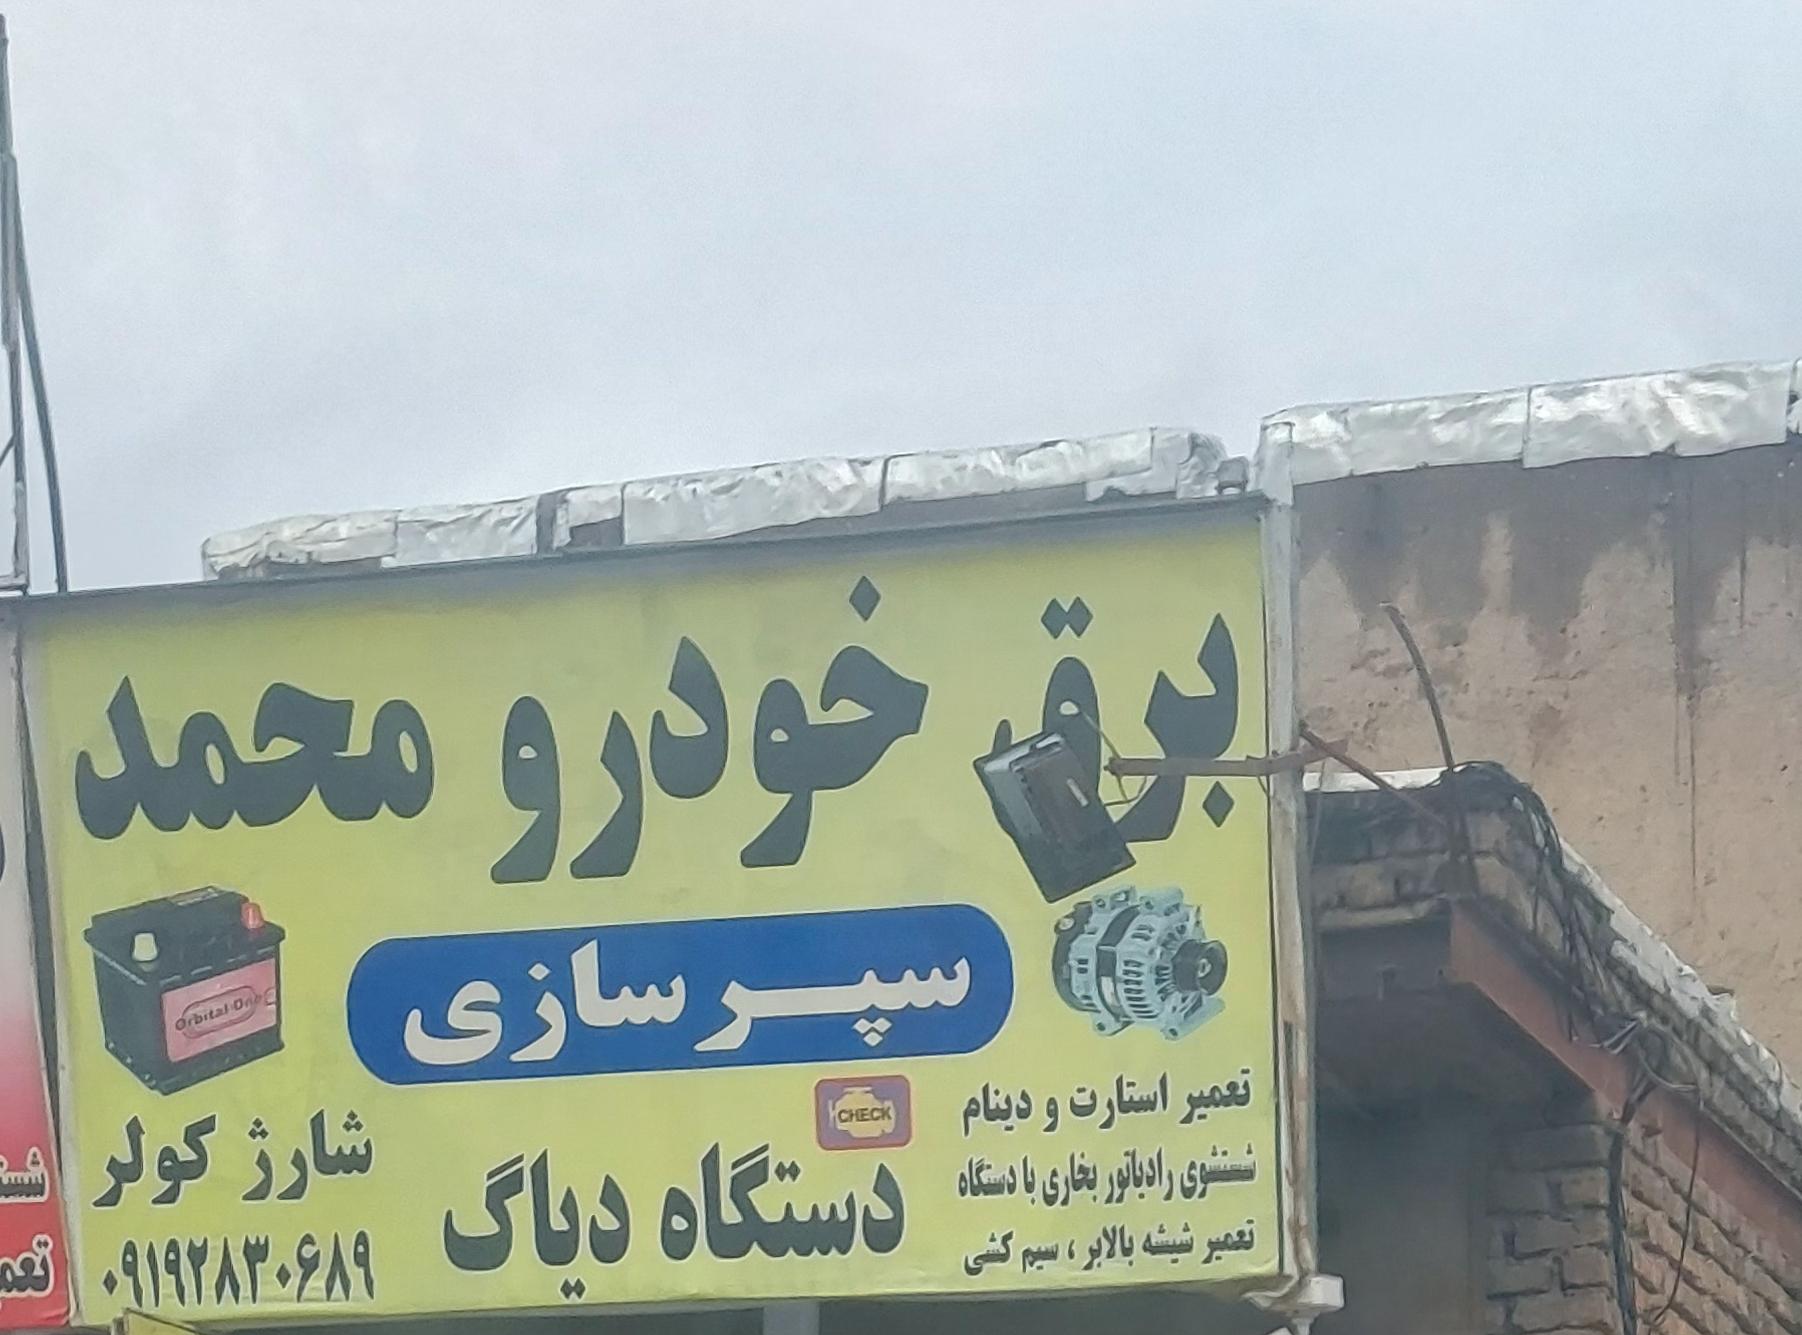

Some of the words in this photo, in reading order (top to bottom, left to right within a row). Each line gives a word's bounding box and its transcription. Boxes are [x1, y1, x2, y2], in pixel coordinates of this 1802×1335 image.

[75, 675, 435, 840] محمد
[490, 575, 929, 884] خودرو
[403, 938, 686, 1065] سازی
[693, 955, 971, 1052] سپر
[837, 1106, 893, 1124] CHECK
[963, 1082, 1032, 1136] دینام
[1043, 1097, 1059, 1132] و
[1070, 1072, 1168, 1129] استارت
[1180, 1068, 1250, 1124] تعمیر
[92, 1114, 217, 1207] کولر
[241, 1109, 373, 1201] شارژ
[958, 1157, 1017, 1197] دستگاه
[1022, 1155, 1036, 1205] با
[1043, 1152, 1097, 1206] بخاری
[1104, 1147, 1173, 1204] رادیاتور
[443, 1150, 631, 1301] دیاگ
[660, 1142, 905, 1262] دستگاه
[103, 1230, 374, 1308] ۰۹۱۹۲۸۳۰۶۸۹
[964, 1231, 1014, 1275] کشی
[1022, 1243, 1059, 1272] سیم
[1142, 1222, 1194, 1263] شیشه
[1201, 1219, 1255, 1264] تعمیر
